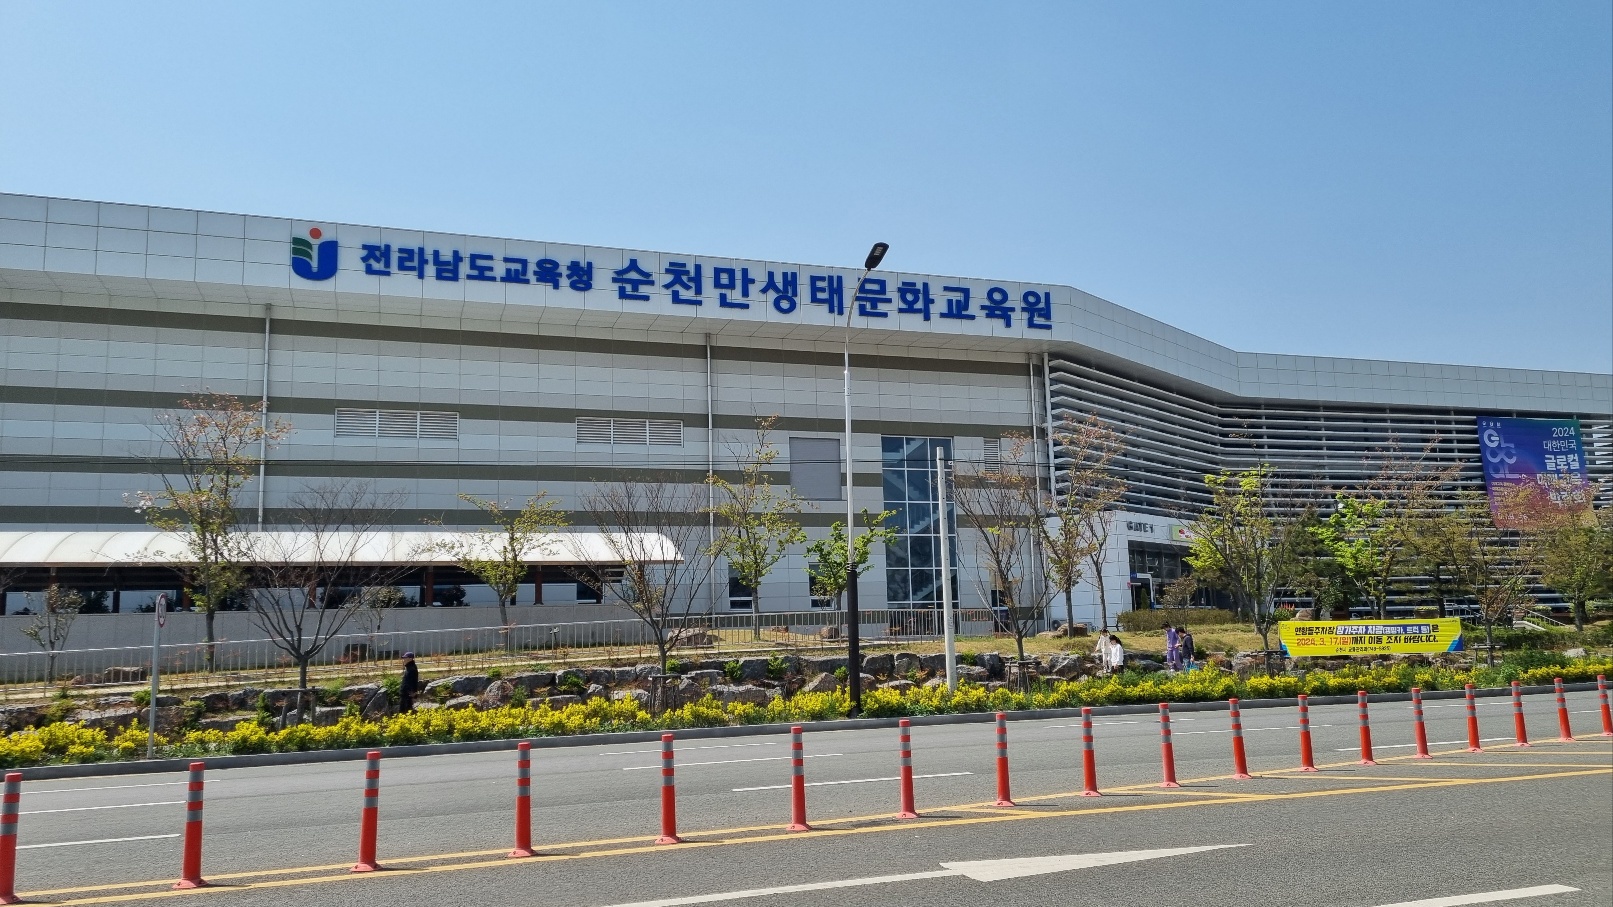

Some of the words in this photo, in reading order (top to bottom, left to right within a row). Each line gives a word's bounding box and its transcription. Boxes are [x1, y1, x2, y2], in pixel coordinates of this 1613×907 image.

[360, 243, 594, 292] 전라남도교육청
[611, 258, 1053, 329] 순천만생태문화교육원
[1552, 427, 1576, 438] 2024
[1543, 439, 1577, 452] 대한민국
[1544, 453, 1580, 471] 글로컬
[1296, 637, 1318, 647] 2024.
[1368, 635, 1383, 644] 이동
[1385, 635, 1402, 644] 조치
[1403, 634, 1439, 644] 바랍니다.
